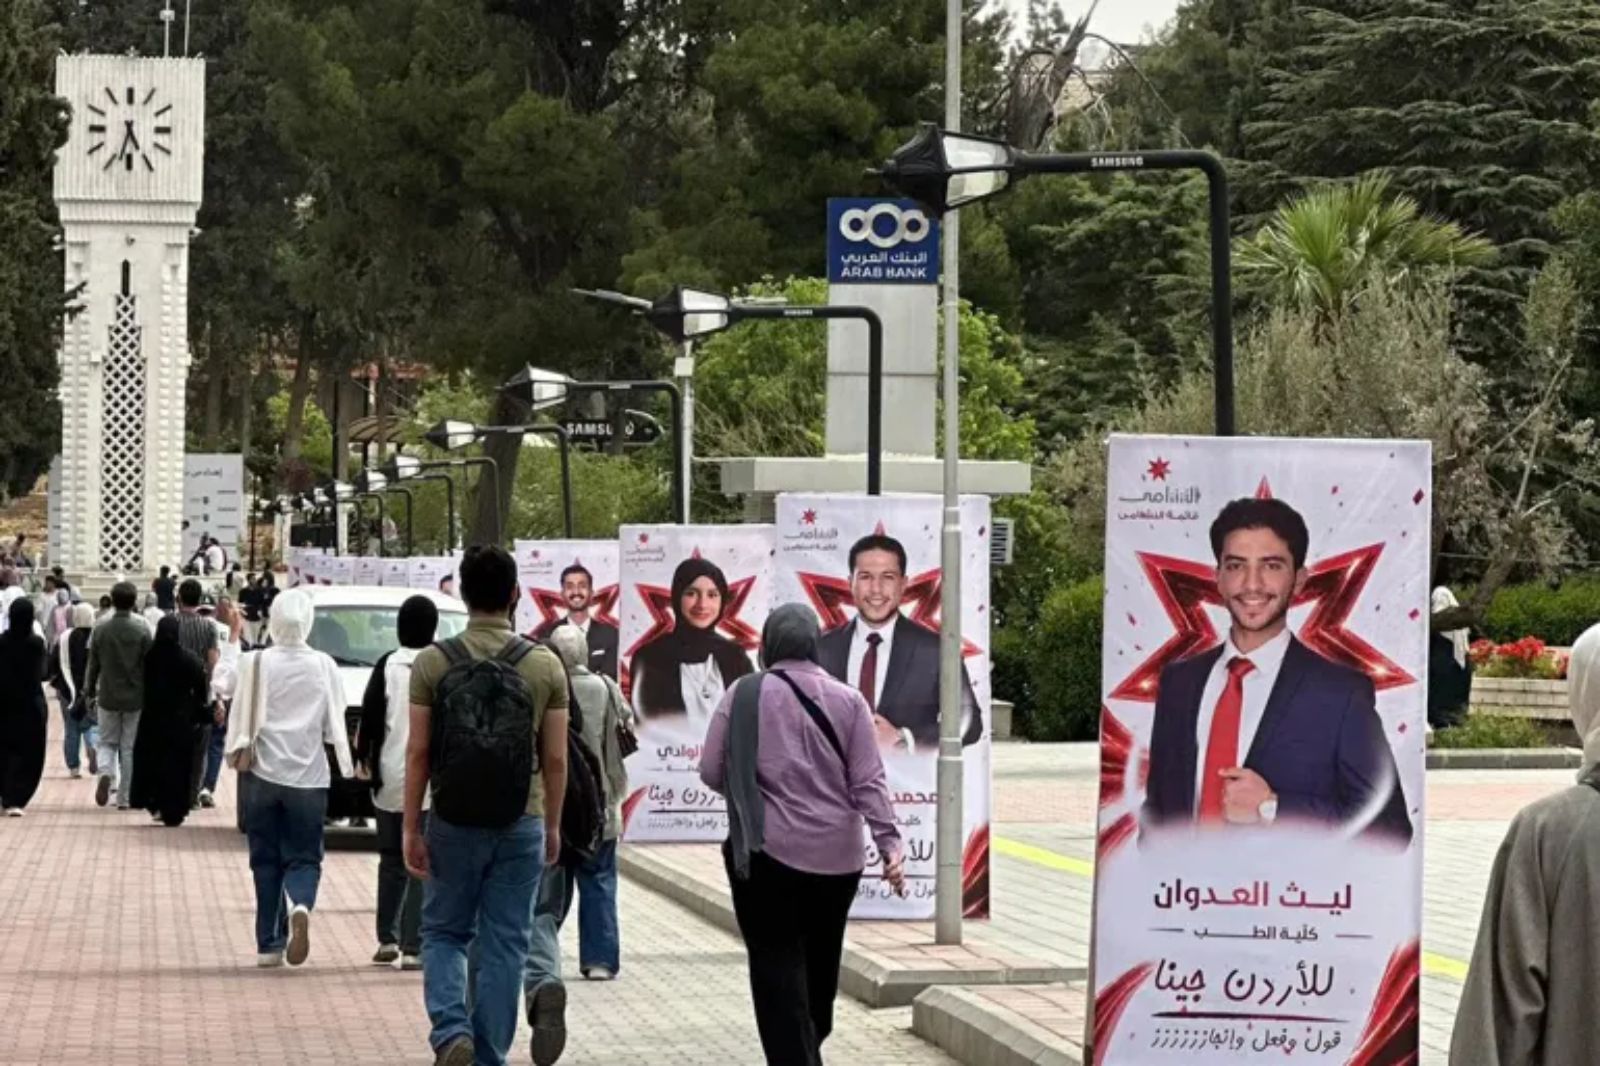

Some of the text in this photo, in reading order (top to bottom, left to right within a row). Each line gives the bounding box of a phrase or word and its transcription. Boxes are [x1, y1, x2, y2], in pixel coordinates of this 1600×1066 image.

[840, 251, 928, 266] البنك العربي
[840, 266, 927, 279] ARAB BANK
[1153, 878, 1352, 916] ليث العدوان
[1193, 925, 1277, 940] الطب
[1154, 958, 1335, 1007] للأردن جينا
